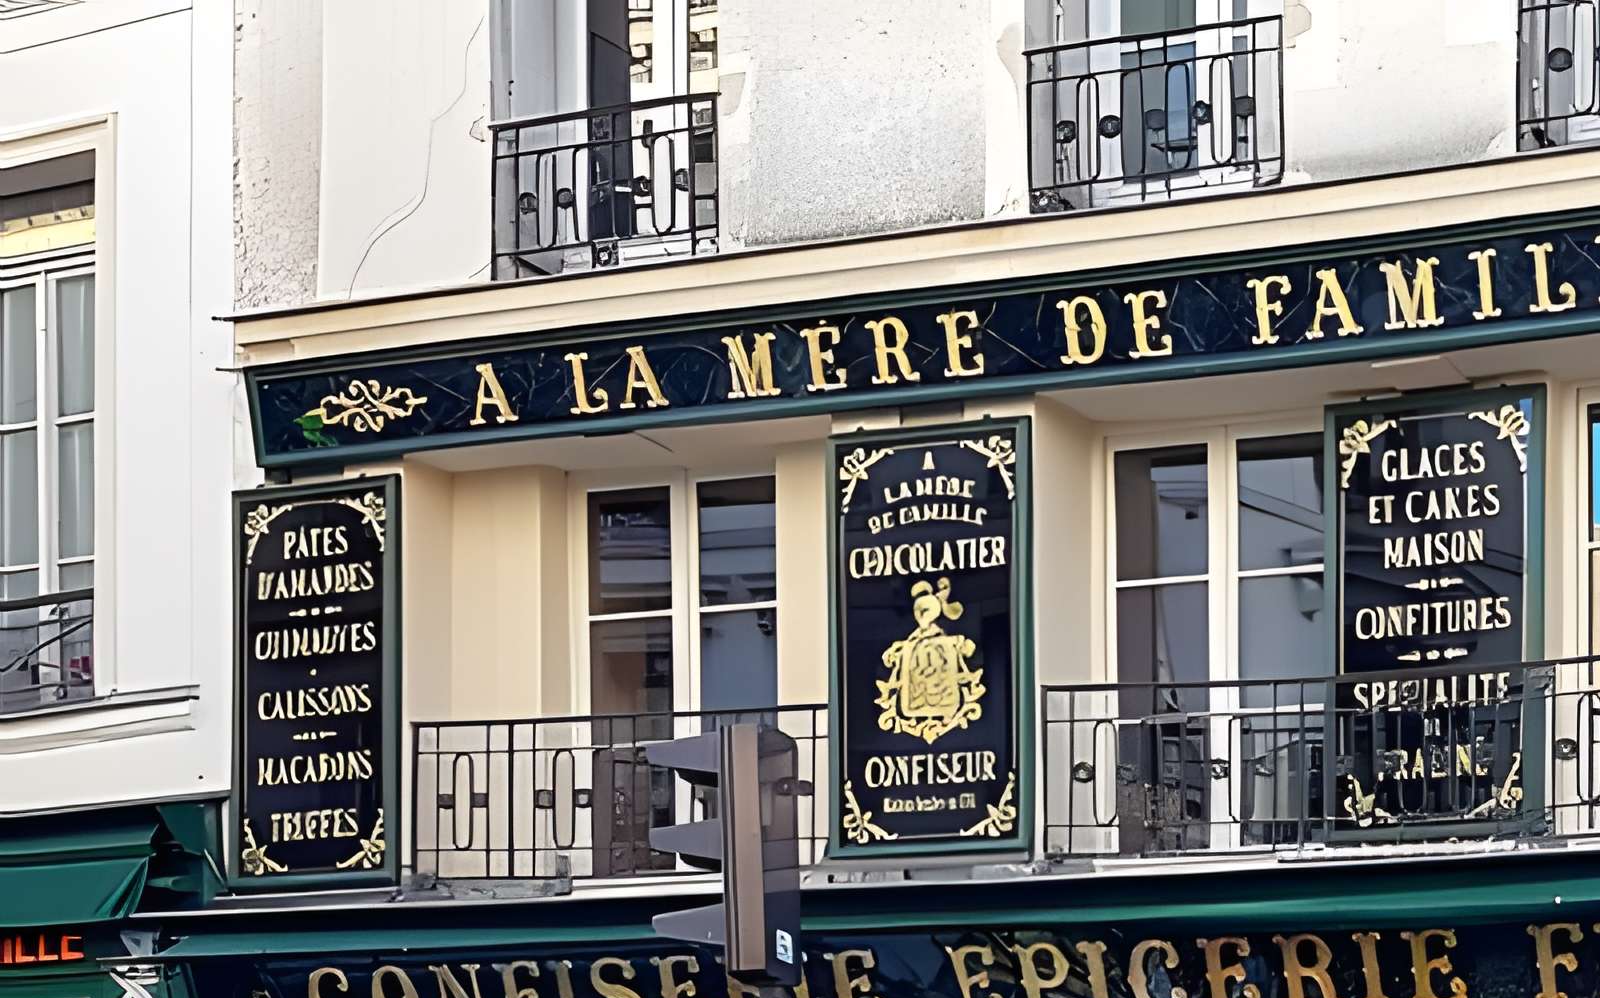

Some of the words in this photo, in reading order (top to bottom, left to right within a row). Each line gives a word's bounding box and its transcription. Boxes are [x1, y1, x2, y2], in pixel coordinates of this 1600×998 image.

[469, 362, 519, 425] A
[563, 345, 670, 415] LA
[1056, 288, 1174, 365] DE
[1369, 495, 1395, 524] ET
[1405, 484, 1500, 524] CAKES
[1384, 528, 1484, 569] MAISON
